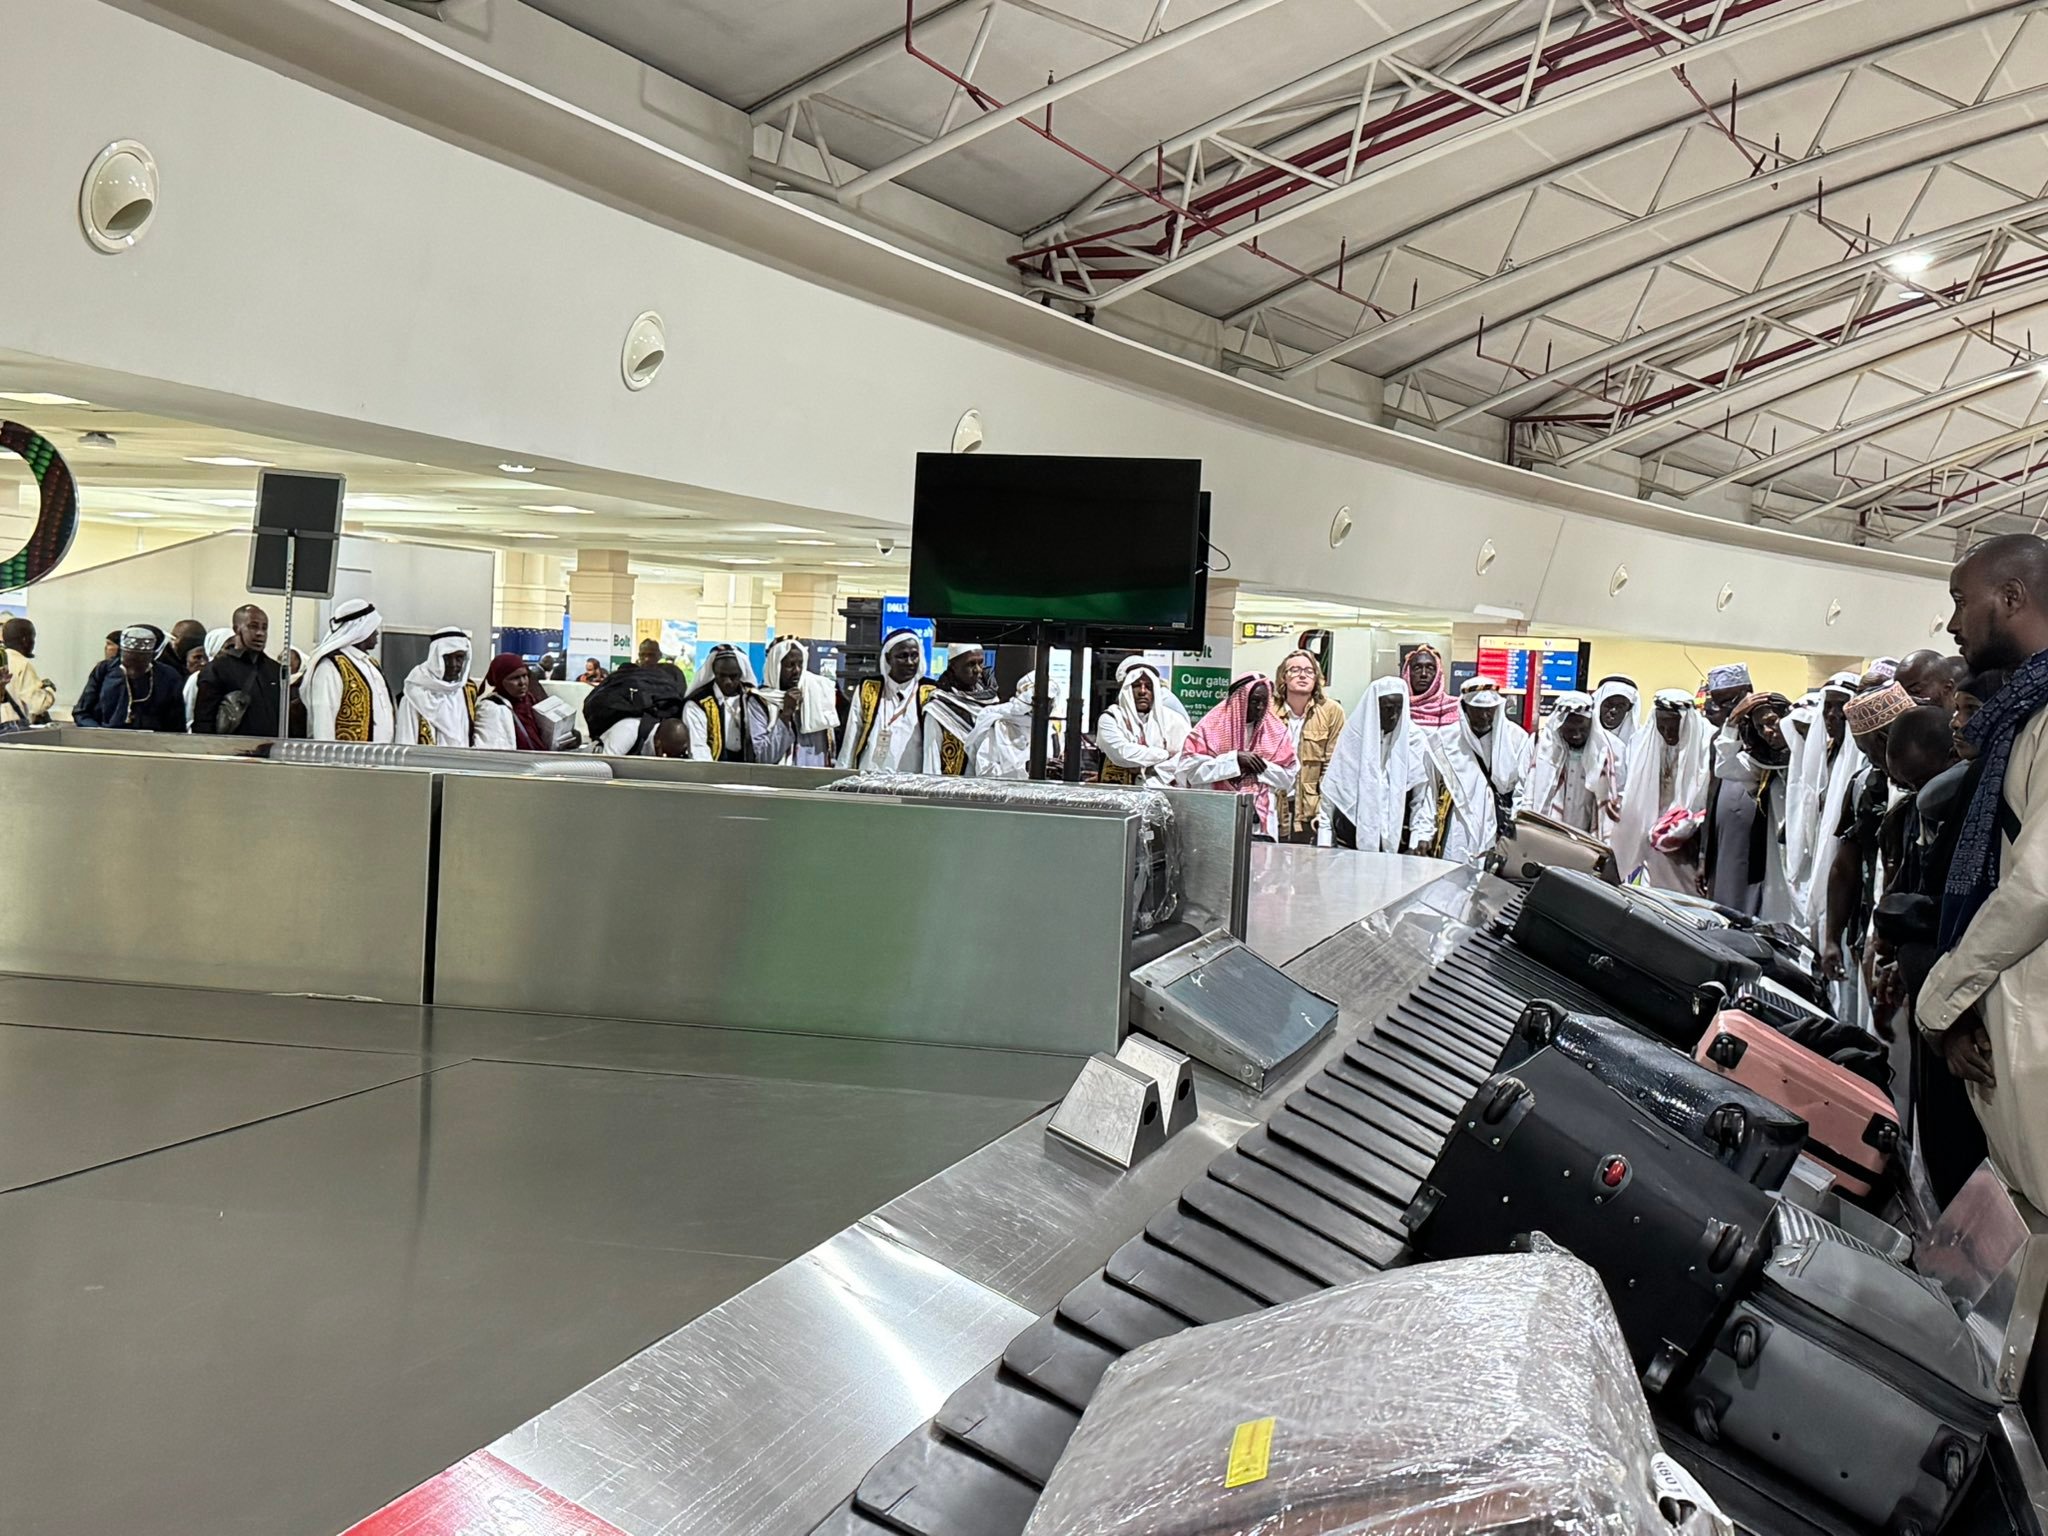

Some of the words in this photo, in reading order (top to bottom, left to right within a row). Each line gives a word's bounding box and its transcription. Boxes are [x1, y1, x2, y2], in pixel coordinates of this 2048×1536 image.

[613, 633, 631, 650] Bolt
[1181, 673, 1203, 685] Our
[1206, 676, 1229, 688] gates
[1180, 688, 1213, 698] never
